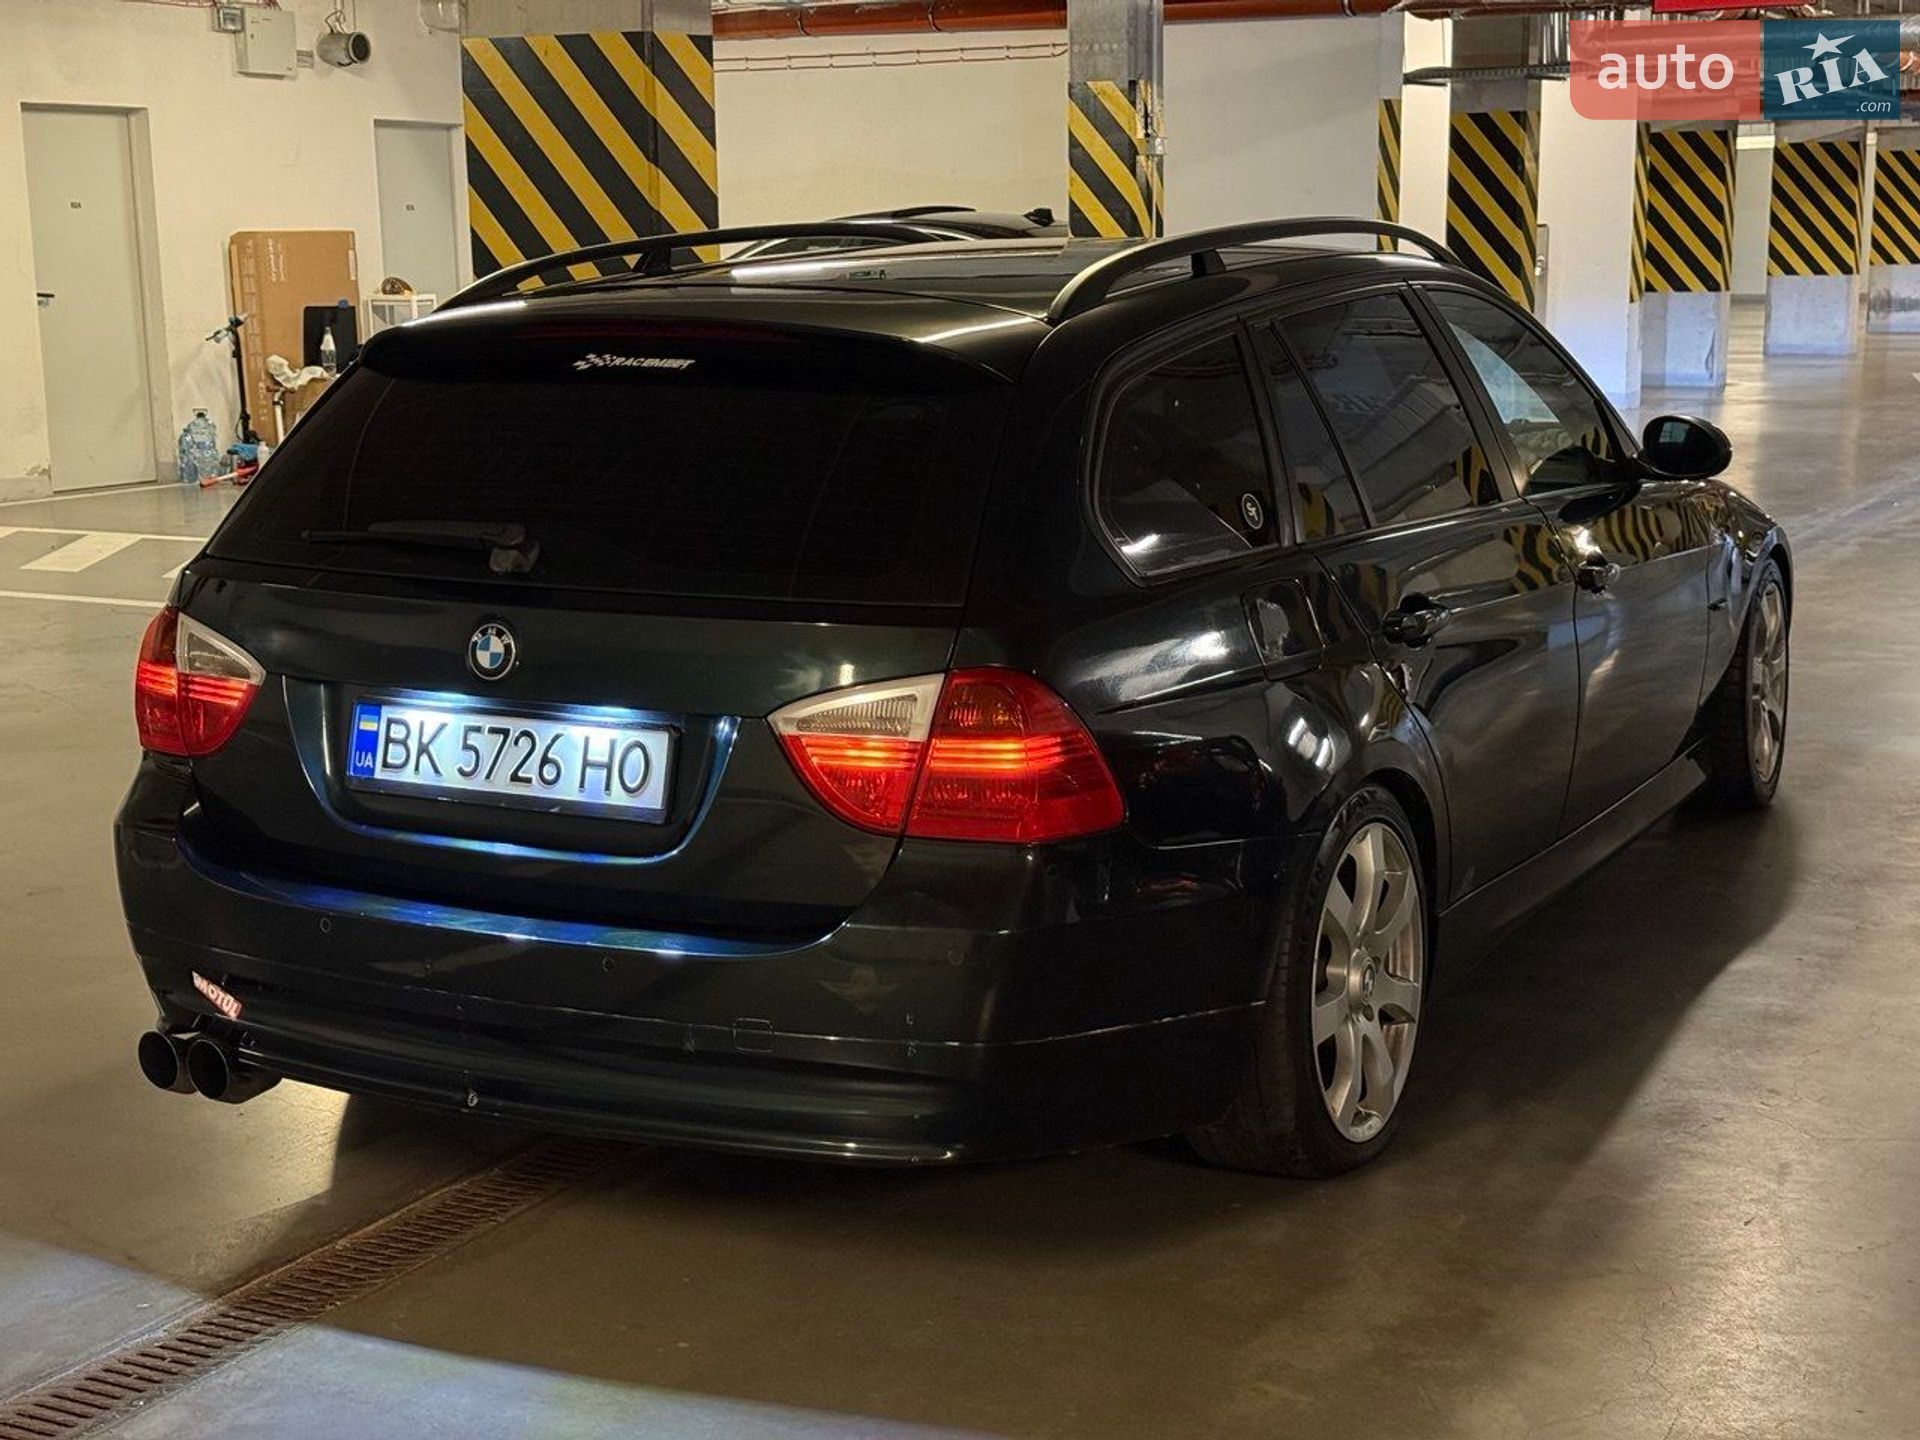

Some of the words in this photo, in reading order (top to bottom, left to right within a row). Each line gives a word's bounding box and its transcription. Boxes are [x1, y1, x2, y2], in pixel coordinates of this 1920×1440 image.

[355, 750, 374, 769] UA
[381, 716, 449, 777] BK
[457, 724, 565, 787] 5726
